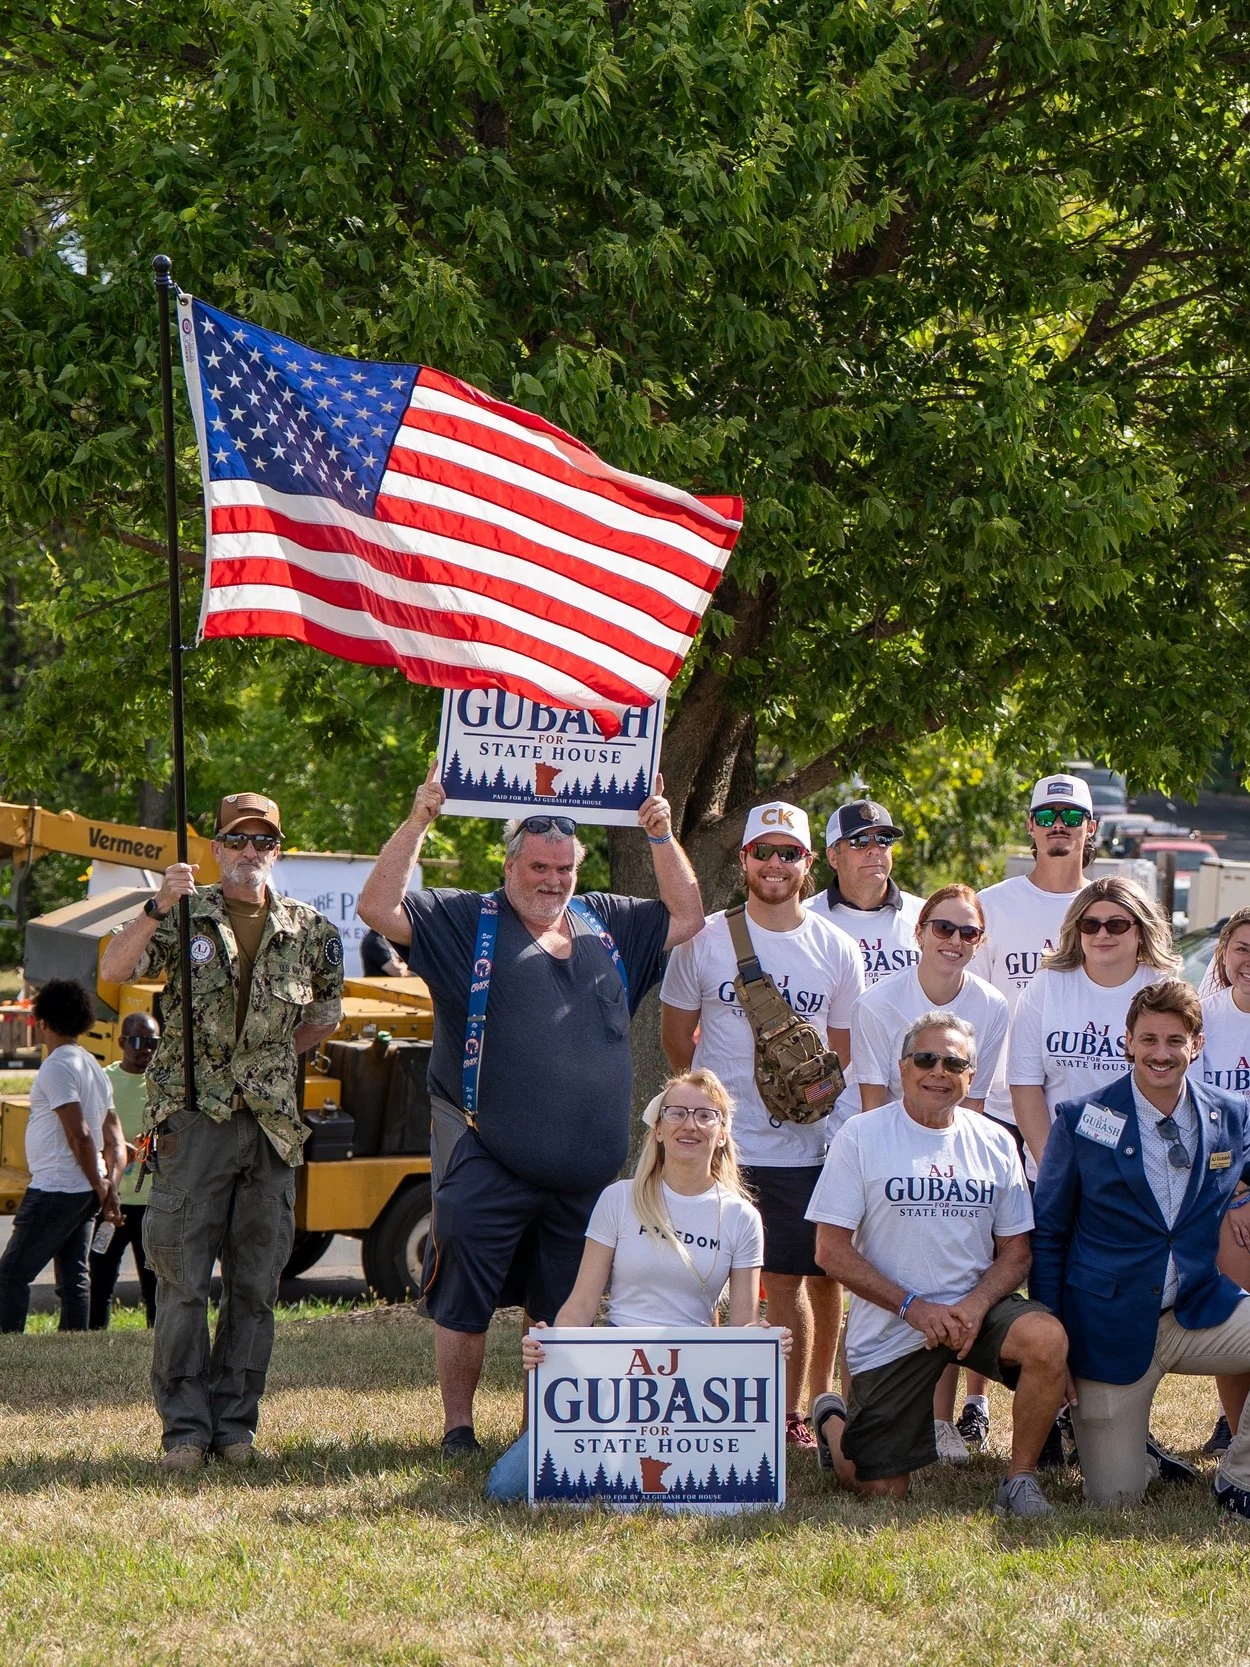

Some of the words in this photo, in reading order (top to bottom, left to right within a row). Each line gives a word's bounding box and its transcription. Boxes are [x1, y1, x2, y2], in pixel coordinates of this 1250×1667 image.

[457, 688, 649, 739] GUBAH
[538, 734, 564, 745] FOR
[479, 742, 543, 759] STATE
[552, 747, 622, 764] HOUSE
[761, 808, 795, 829] CK
[88, 826, 164, 861] Vermeer
[859, 938, 882, 951] AJ
[860, 949, 920, 972] BASH
[718, 980, 824, 1013] GASH
[1083, 1020, 1110, 1037] AJ
[1046, 1031, 1126, 1058] GUBAS
[1055, 1059, 1089, 1069] STATE
[1086, 1055, 1101, 1063] FOR
[1082, 1113, 1121, 1137] GUBASH
[928, 1164, 955, 1178] AJ
[884, 1176, 995, 1205] GUBASH
[899, 1208, 937, 1217] STATE
[942, 1208, 980, 1218] HOUSE
[625, 1348, 682, 1376] AJ
[543, 1377, 770, 1424] GUBASH
[640, 1426, 670, 1436] FOR
[574, 1438, 647, 1453] STATE
[658, 1438, 740, 1453] HOUSE
